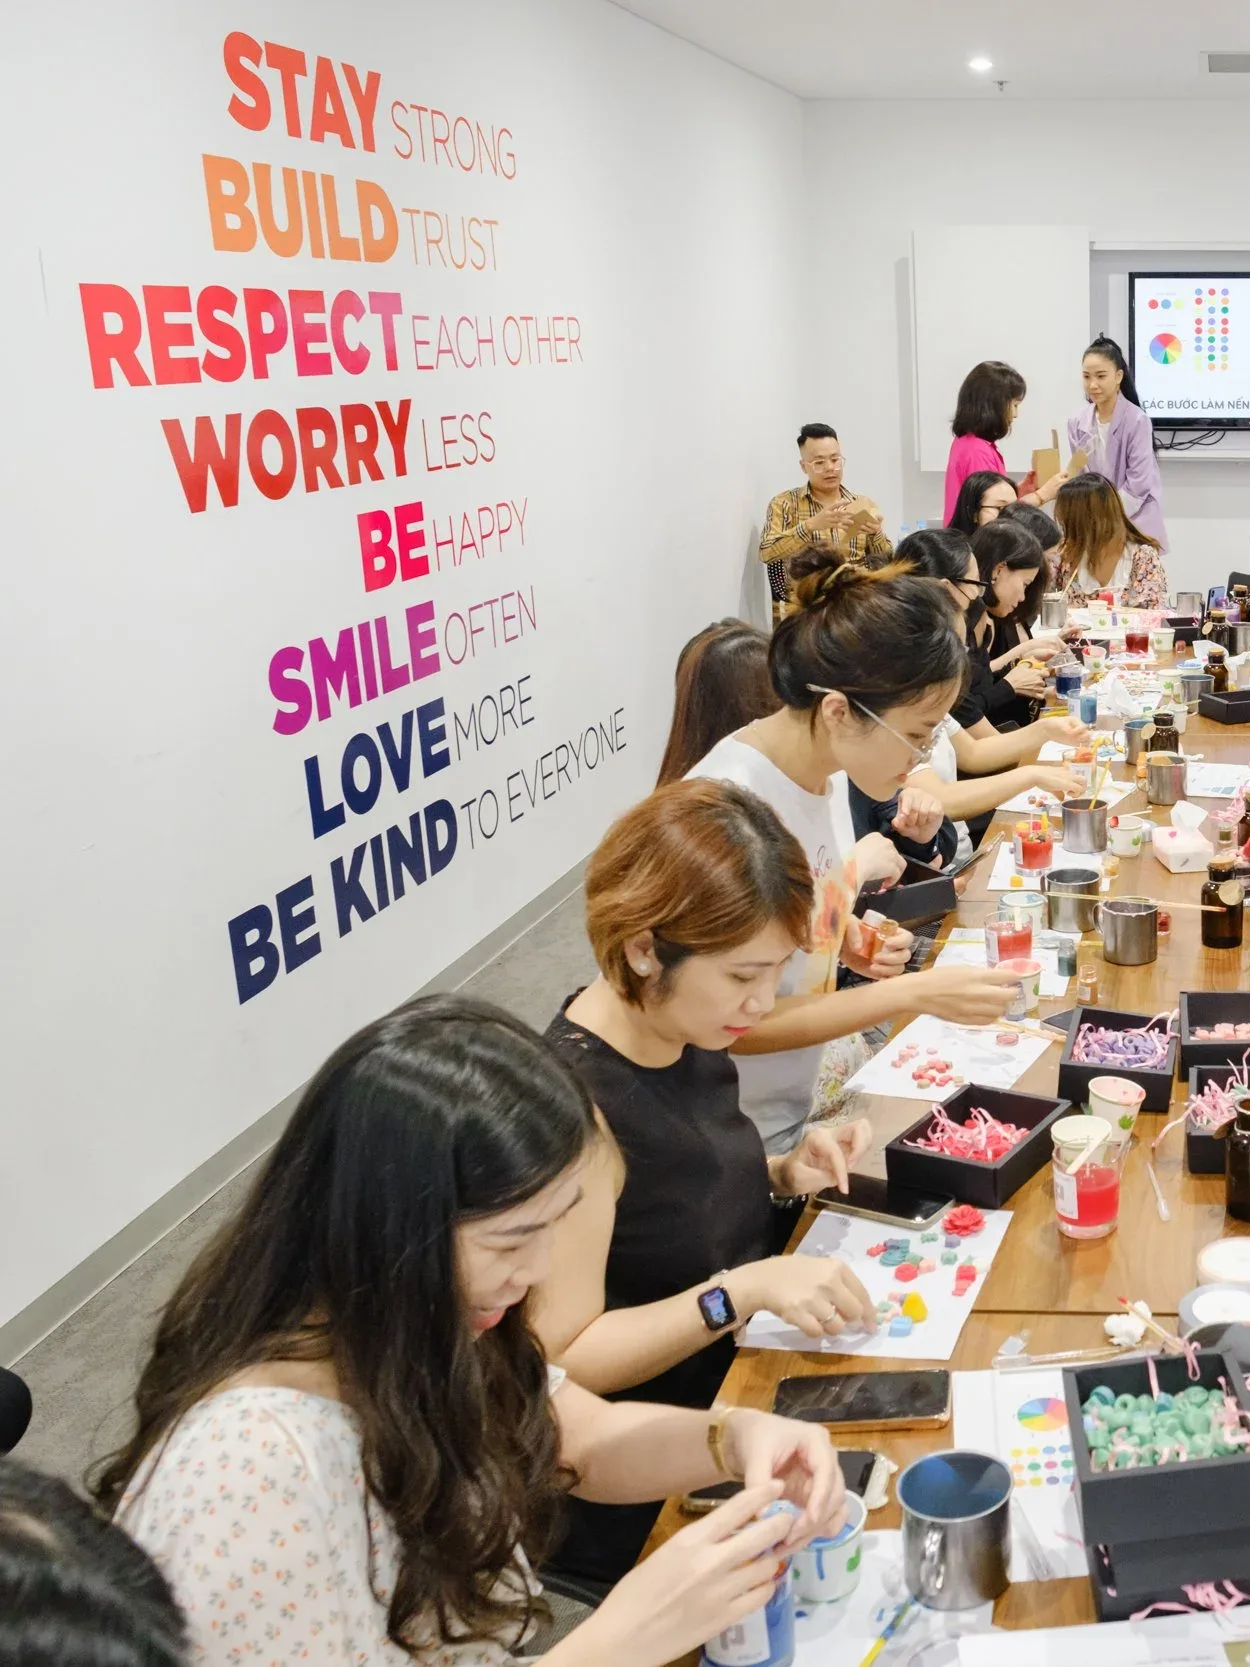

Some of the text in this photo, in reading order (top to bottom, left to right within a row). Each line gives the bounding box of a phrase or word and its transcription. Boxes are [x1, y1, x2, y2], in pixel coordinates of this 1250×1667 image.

[222, 31, 517, 180] STAY STRONG
[201, 153, 499, 271] BUILD TRUST
[78, 283, 584, 390] RESPECT EACH OTHER
[160, 397, 496, 514] WORRY LESS
[1167, 398, 1198, 409] BƯỚC
[1201, 397, 1225, 409] LÀM
[356, 497, 528, 593] BE HAPPY
[268, 585, 537, 736] SMILE OFTEN
[304, 674, 535, 840] LOVE MORE
[228, 707, 627, 1005] BE KIND TO EVERYONE
